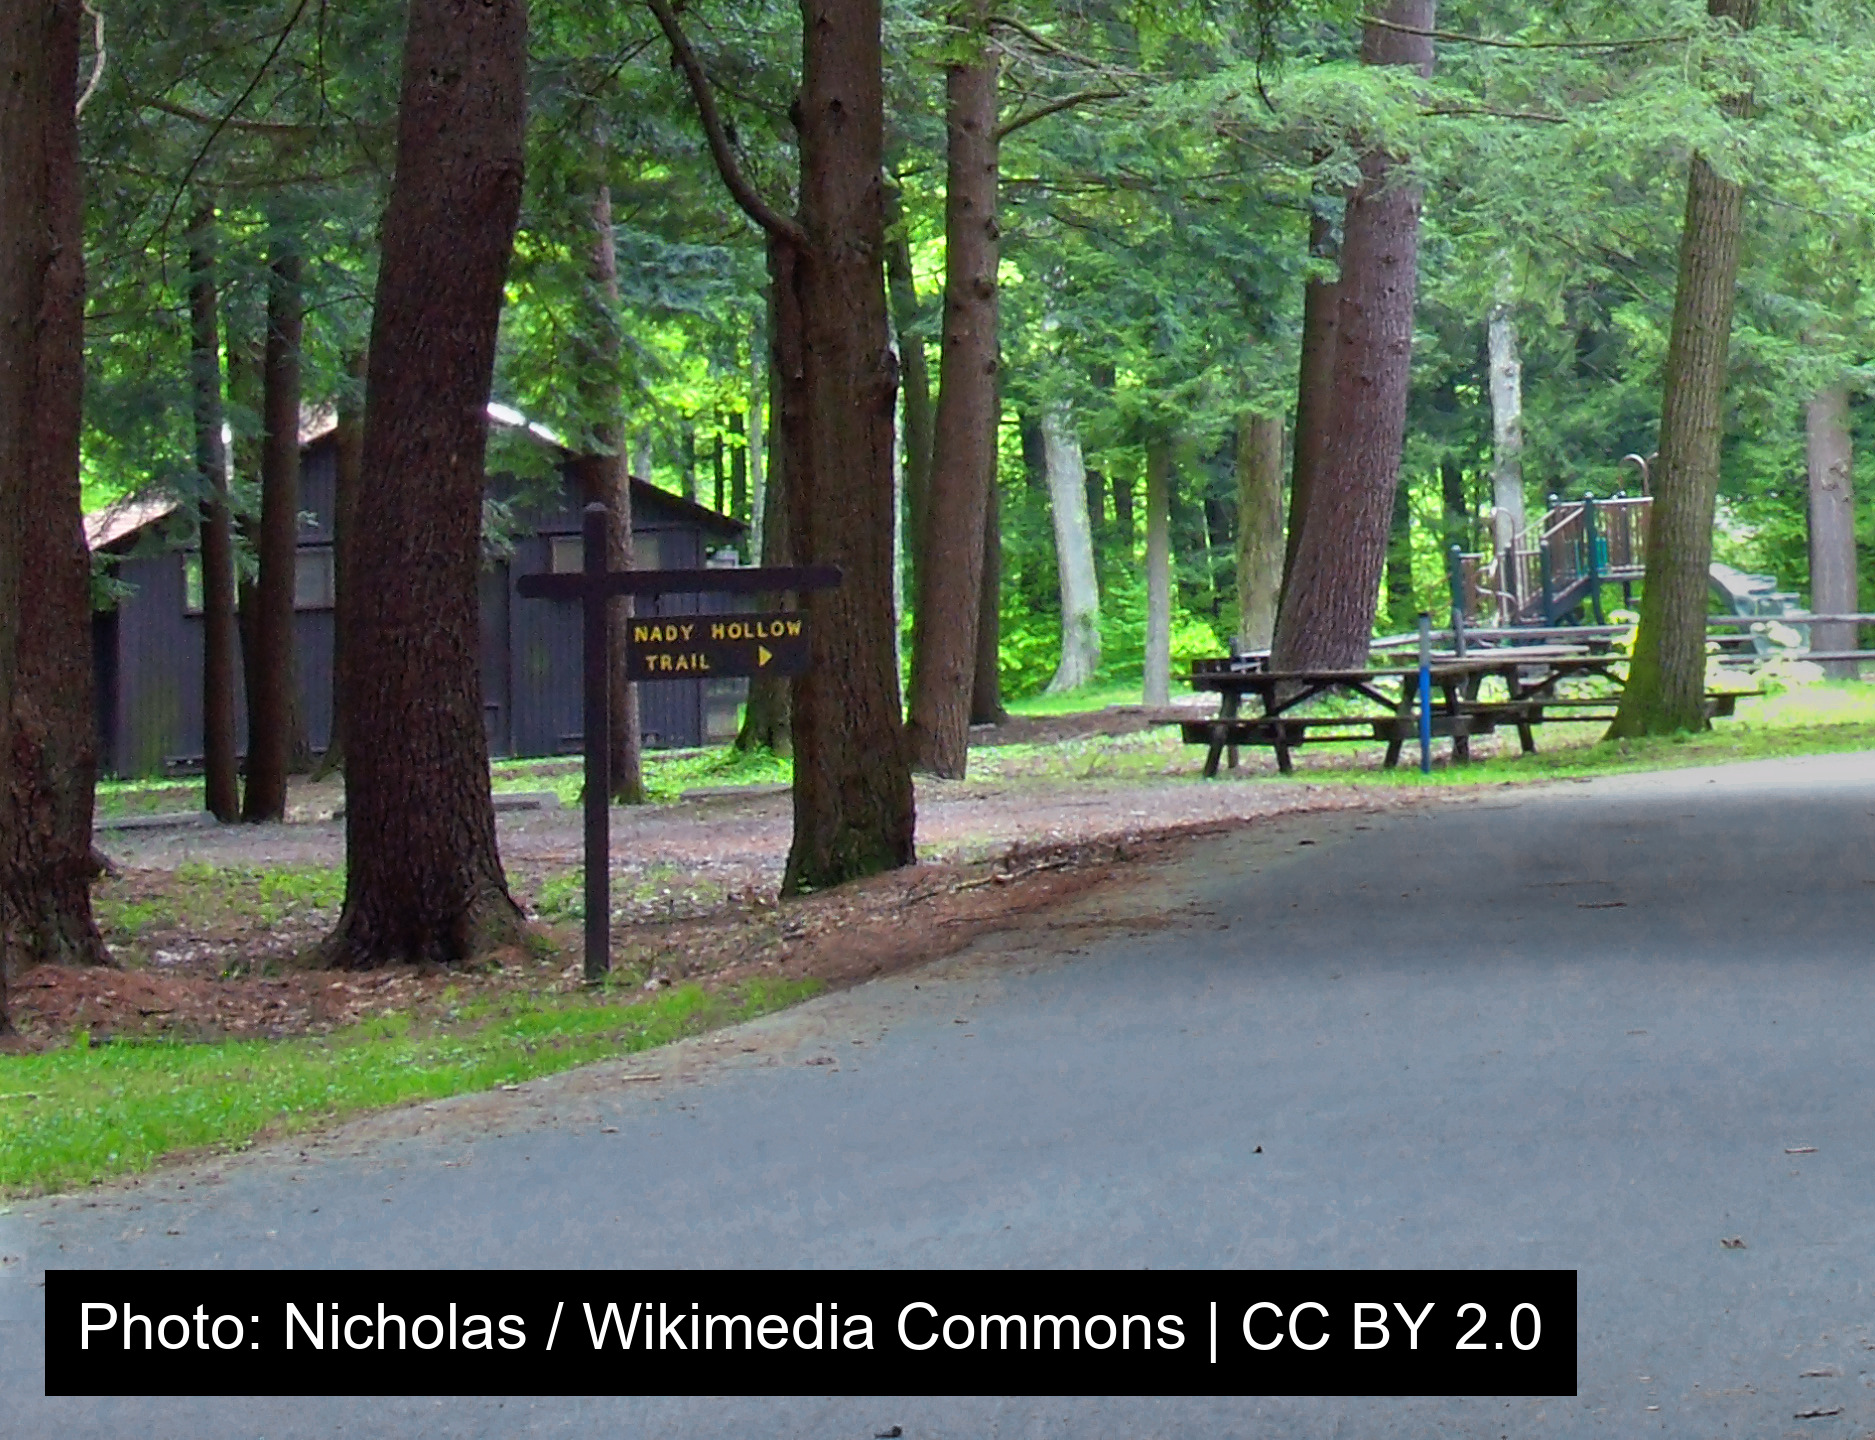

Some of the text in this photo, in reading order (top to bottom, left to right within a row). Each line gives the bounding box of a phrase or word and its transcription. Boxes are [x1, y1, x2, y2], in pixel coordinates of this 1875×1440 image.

[634, 620, 802, 643] NADY HOLLOW
[645, 653, 711, 671] TRAIL
